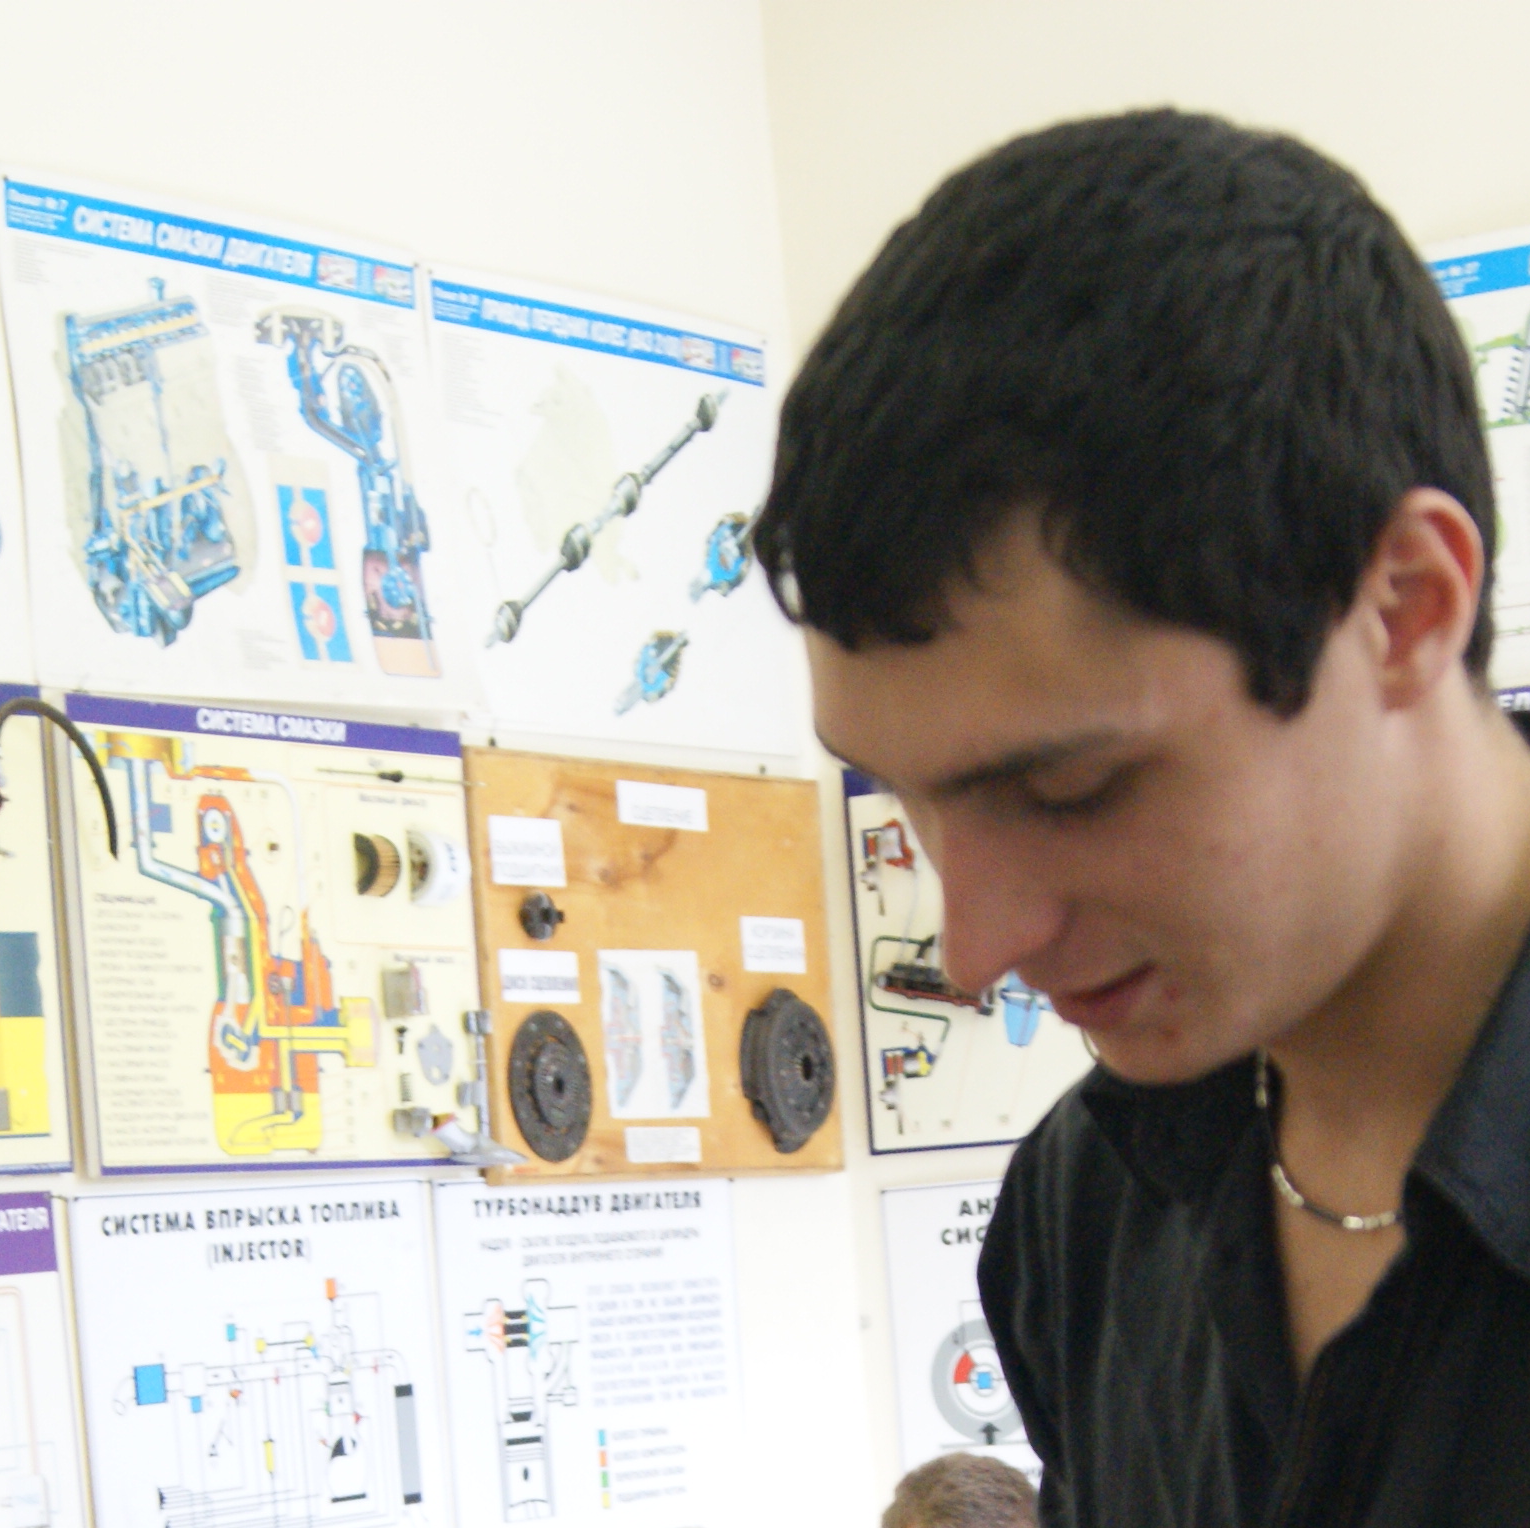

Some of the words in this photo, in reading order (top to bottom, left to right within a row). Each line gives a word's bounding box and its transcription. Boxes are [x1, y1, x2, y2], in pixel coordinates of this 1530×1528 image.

[73, 205, 153, 247] СИСТЕМА
[155, 222, 224, 260] СМАЗКИ
[222, 237, 314, 278] ДВИГАТЕЛЯ
[196, 707, 280, 738] СИСТЕМА
[278, 712, 347, 742] СМАЗКИ
[101, 1211, 196, 1238] СИСТЕМА
[205, 1205, 302, 1231] ВПРЫСКА
[309, 1198, 400, 1223] ТОПЛИВА
[474, 1194, 603, 1219] ТУРБОНАДДУВ
[609, 1191, 702, 1216] ДВИГАТЕЛЯ
[959, 1197, 1000, 1217] АН
[941, 1225, 988, 1246] СИС
[207, 1236, 312, 1270] (INJECTOR)
